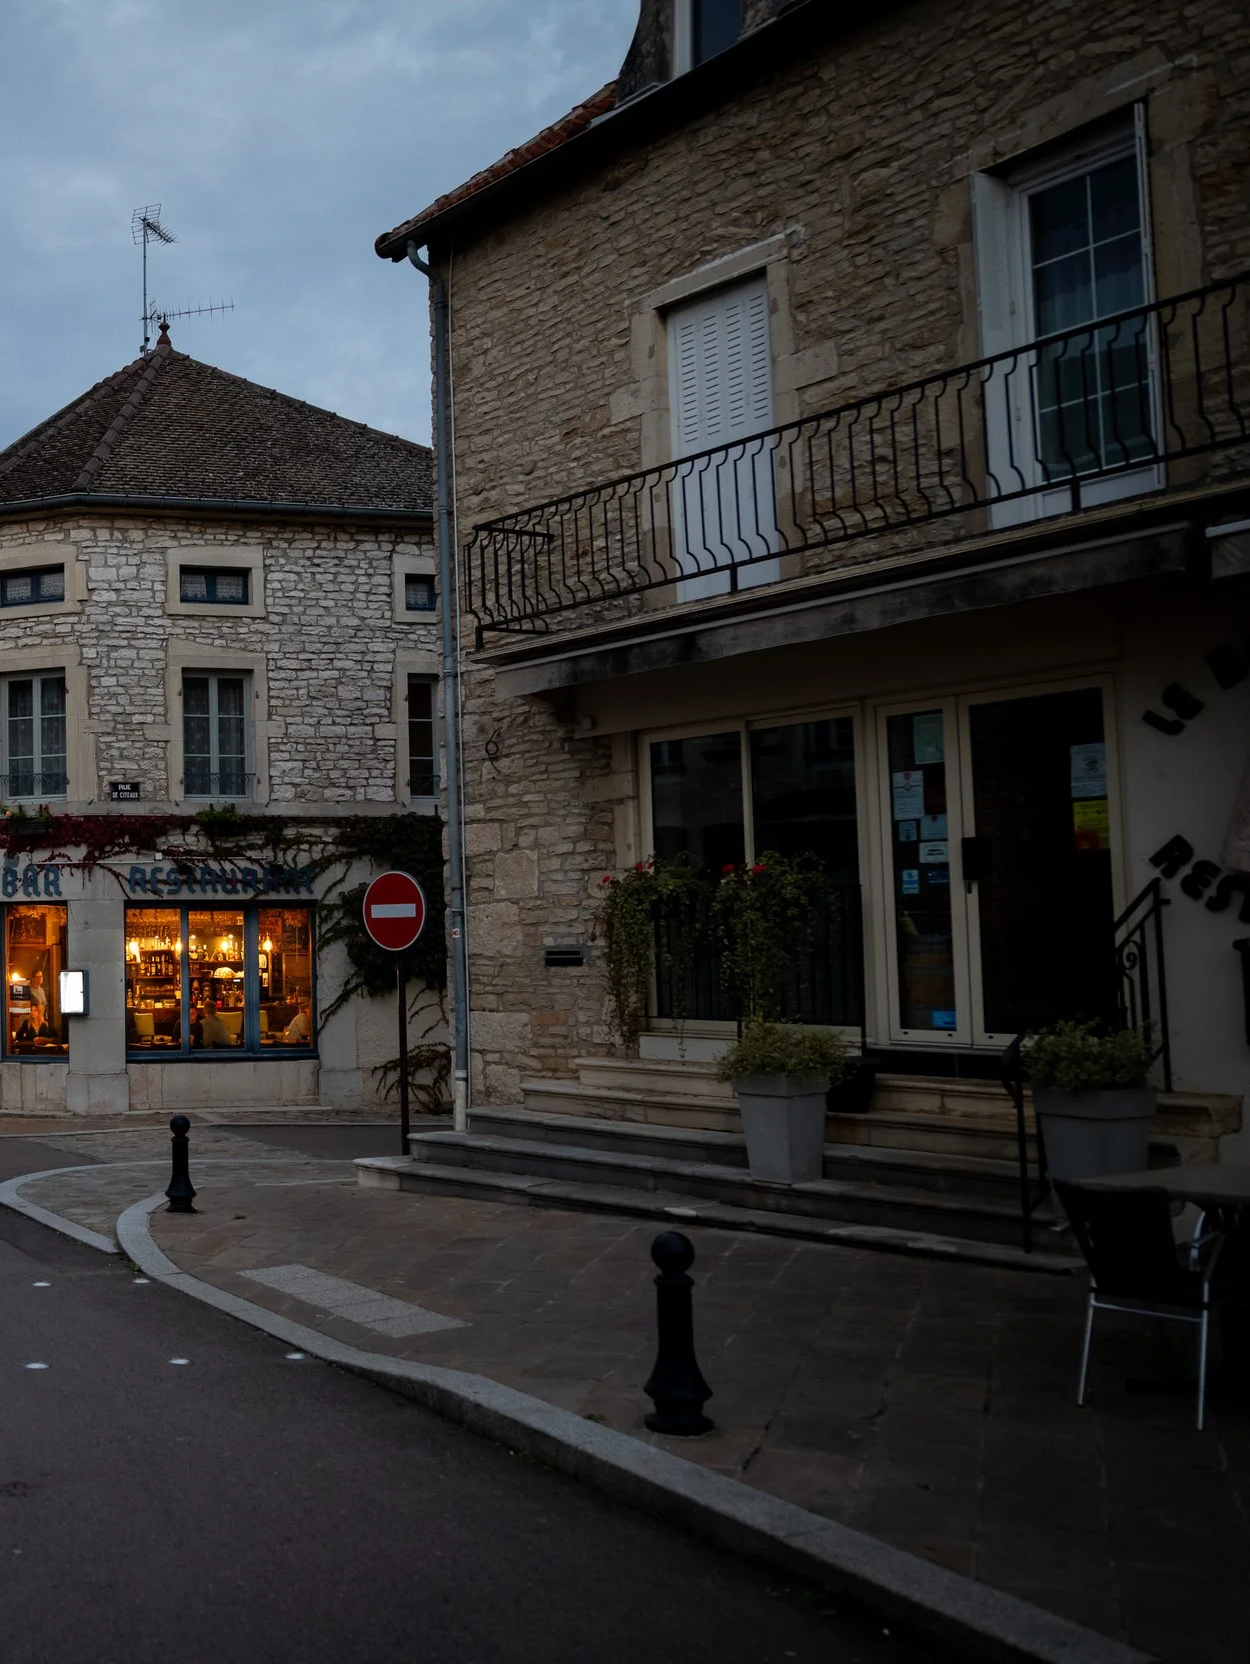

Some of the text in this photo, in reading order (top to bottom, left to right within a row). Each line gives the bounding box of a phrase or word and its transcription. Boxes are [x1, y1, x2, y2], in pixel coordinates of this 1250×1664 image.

[1142, 681, 1204, 735] LE
[2, 864, 62, 897] BAR
[1150, 834, 1250, 923] RES
